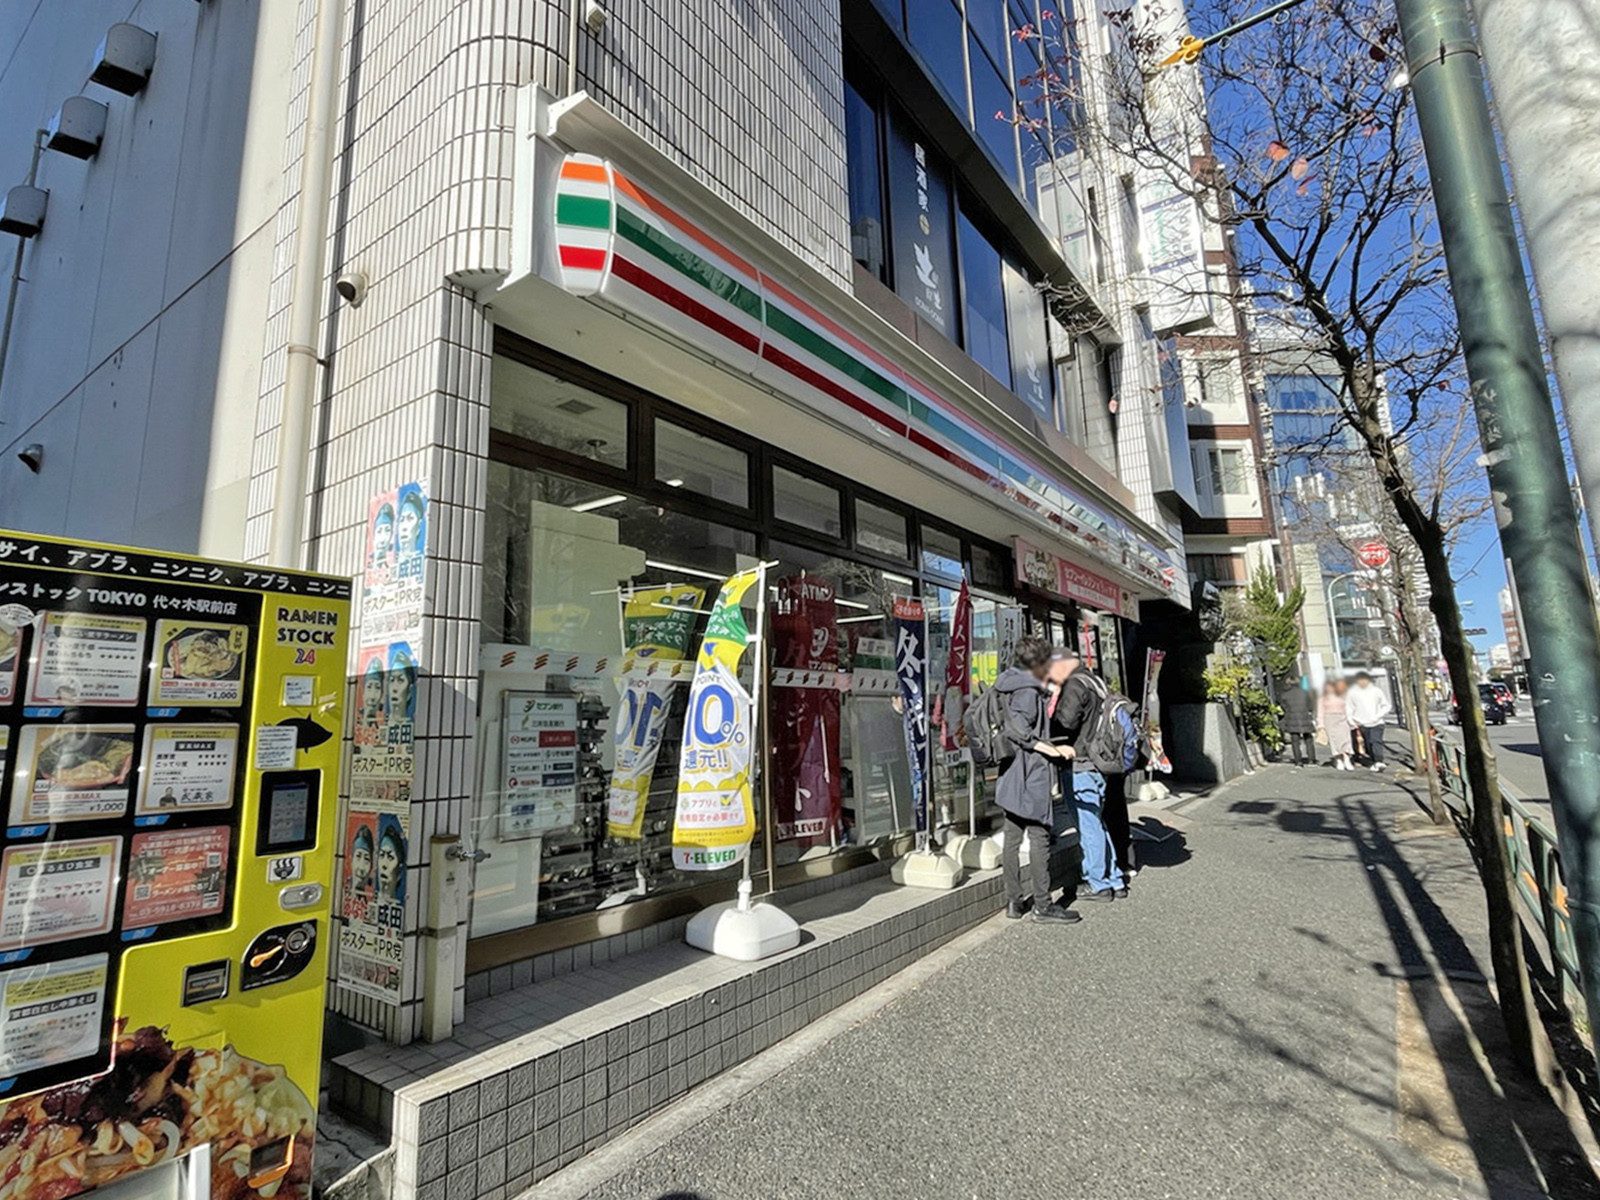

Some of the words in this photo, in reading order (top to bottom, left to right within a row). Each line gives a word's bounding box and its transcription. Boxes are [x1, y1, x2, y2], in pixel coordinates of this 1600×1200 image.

[87, 588, 147, 607] TOKYO
[153, 594, 238, 616] 代々木駅前店
[277, 607, 338, 626] RAMEN
[277, 628, 335, 645] STOCK
[294, 649, 316, 665] 24
[207, 691, 238, 700] ¥1,000
[389, 724, 412, 744] 成田
[684, 750, 728, 770] 還元!!
[89, 802, 124, 812] ¥1,000
[379, 904, 402, 929] 成田
